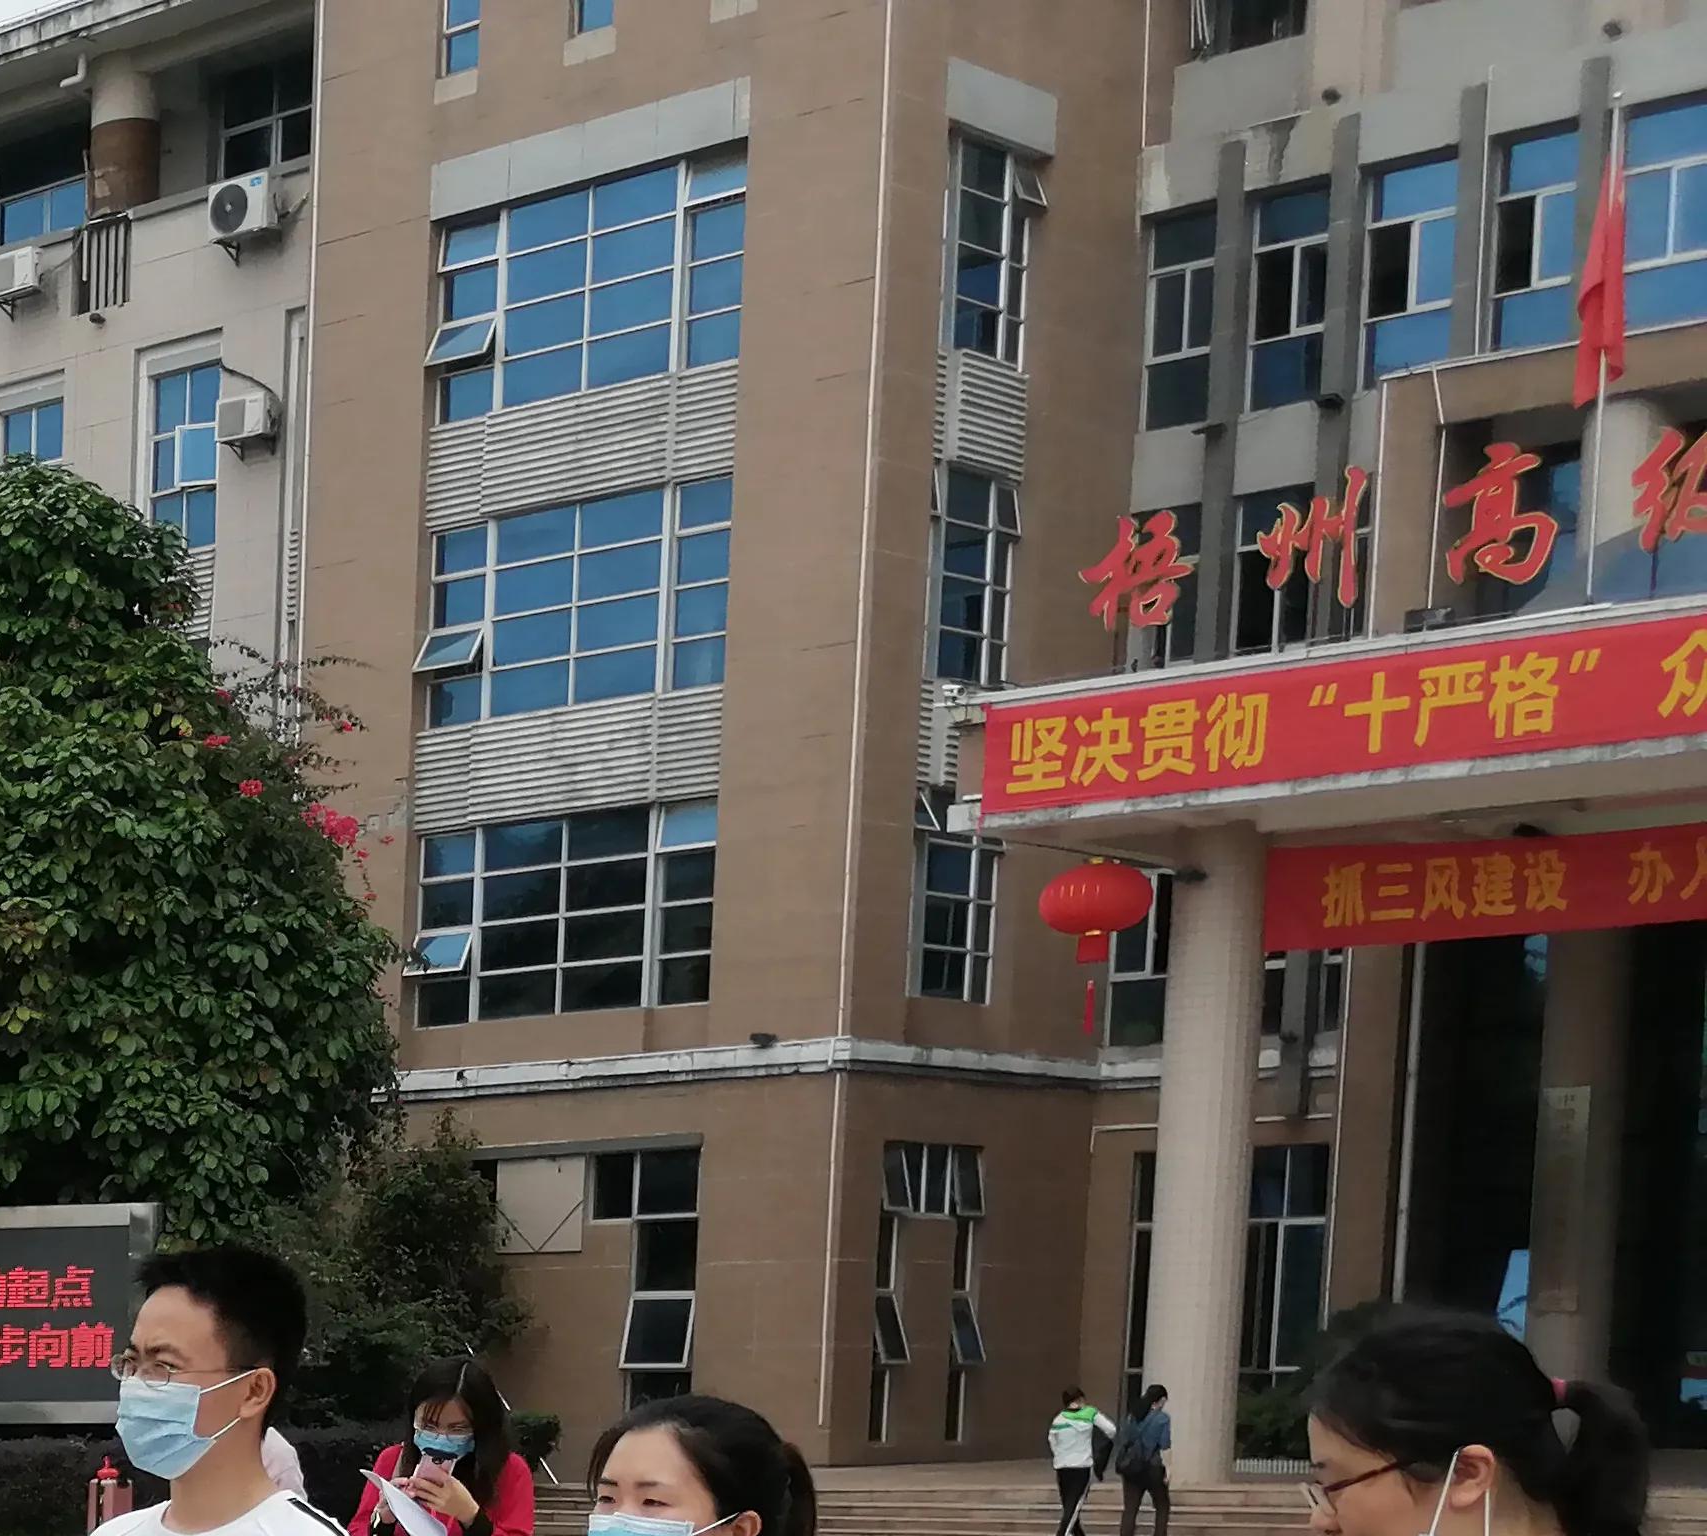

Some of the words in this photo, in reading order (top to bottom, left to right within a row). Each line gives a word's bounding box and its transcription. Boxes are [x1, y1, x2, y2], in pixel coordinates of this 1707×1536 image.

[1321, 848, 1568, 930] 抓三风建设
